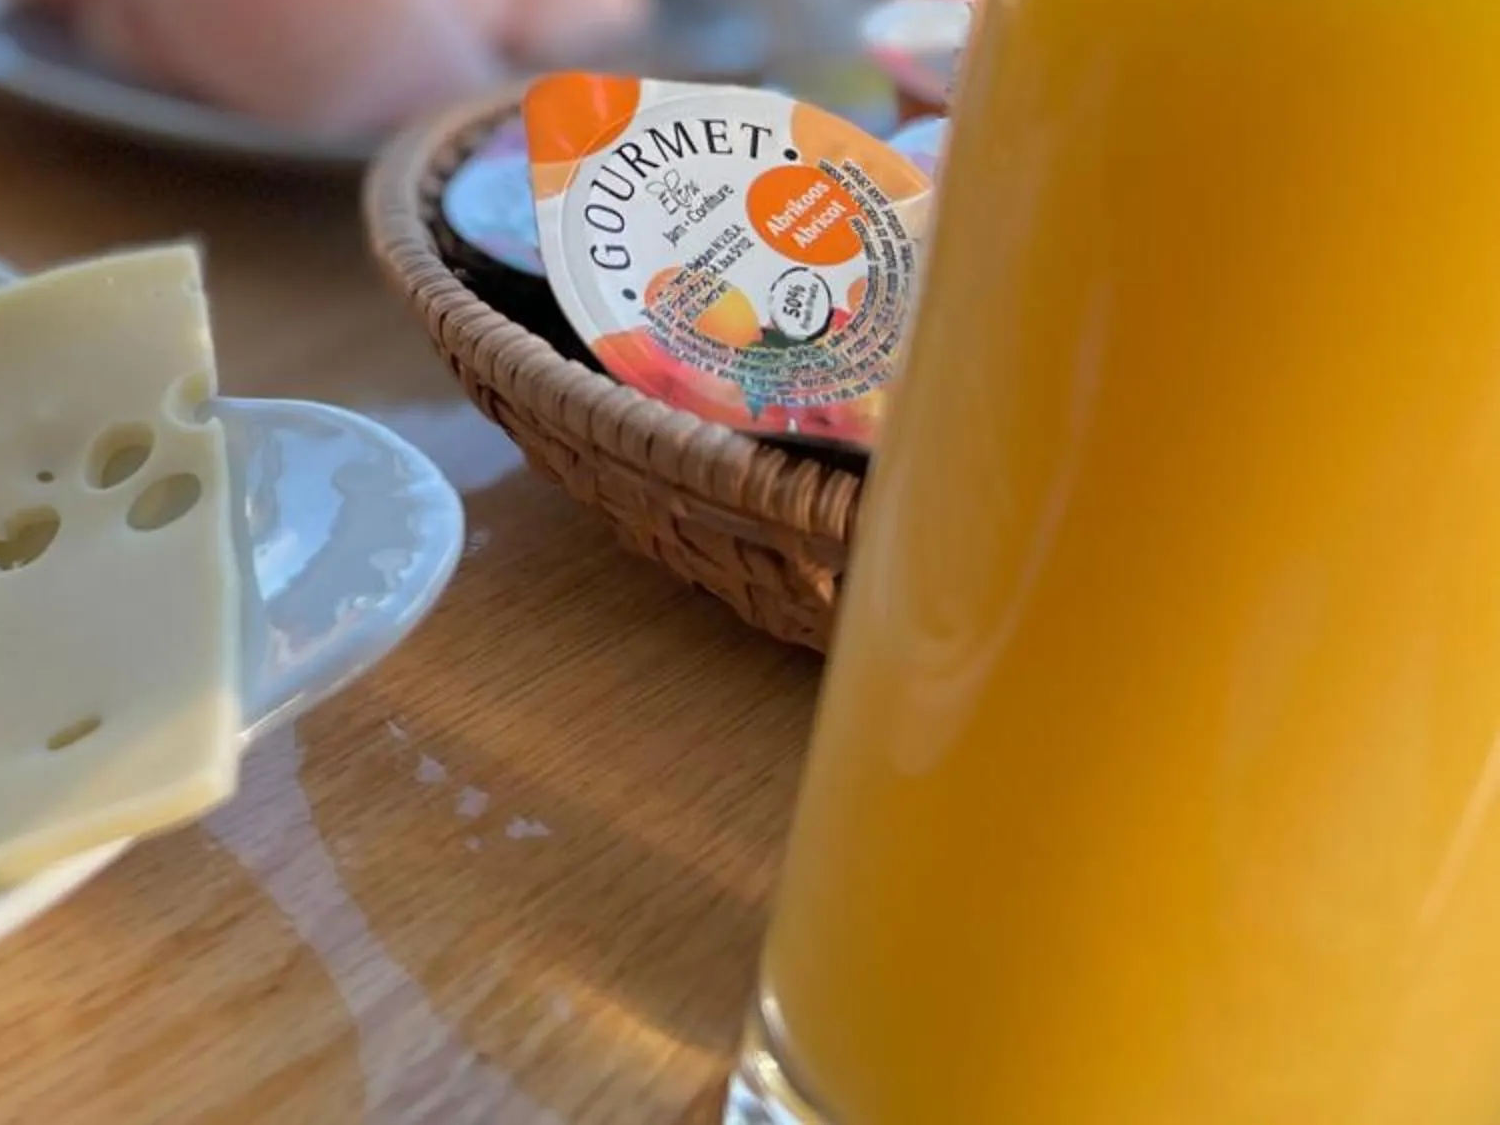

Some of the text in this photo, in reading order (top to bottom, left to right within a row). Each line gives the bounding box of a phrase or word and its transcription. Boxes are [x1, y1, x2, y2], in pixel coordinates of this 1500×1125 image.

[584, 118, 773, 271] GOURMET
[765, 179, 830, 238] Abrikoos
[791, 200, 847, 250] Abricot
[782, 283, 807, 319] 50%
